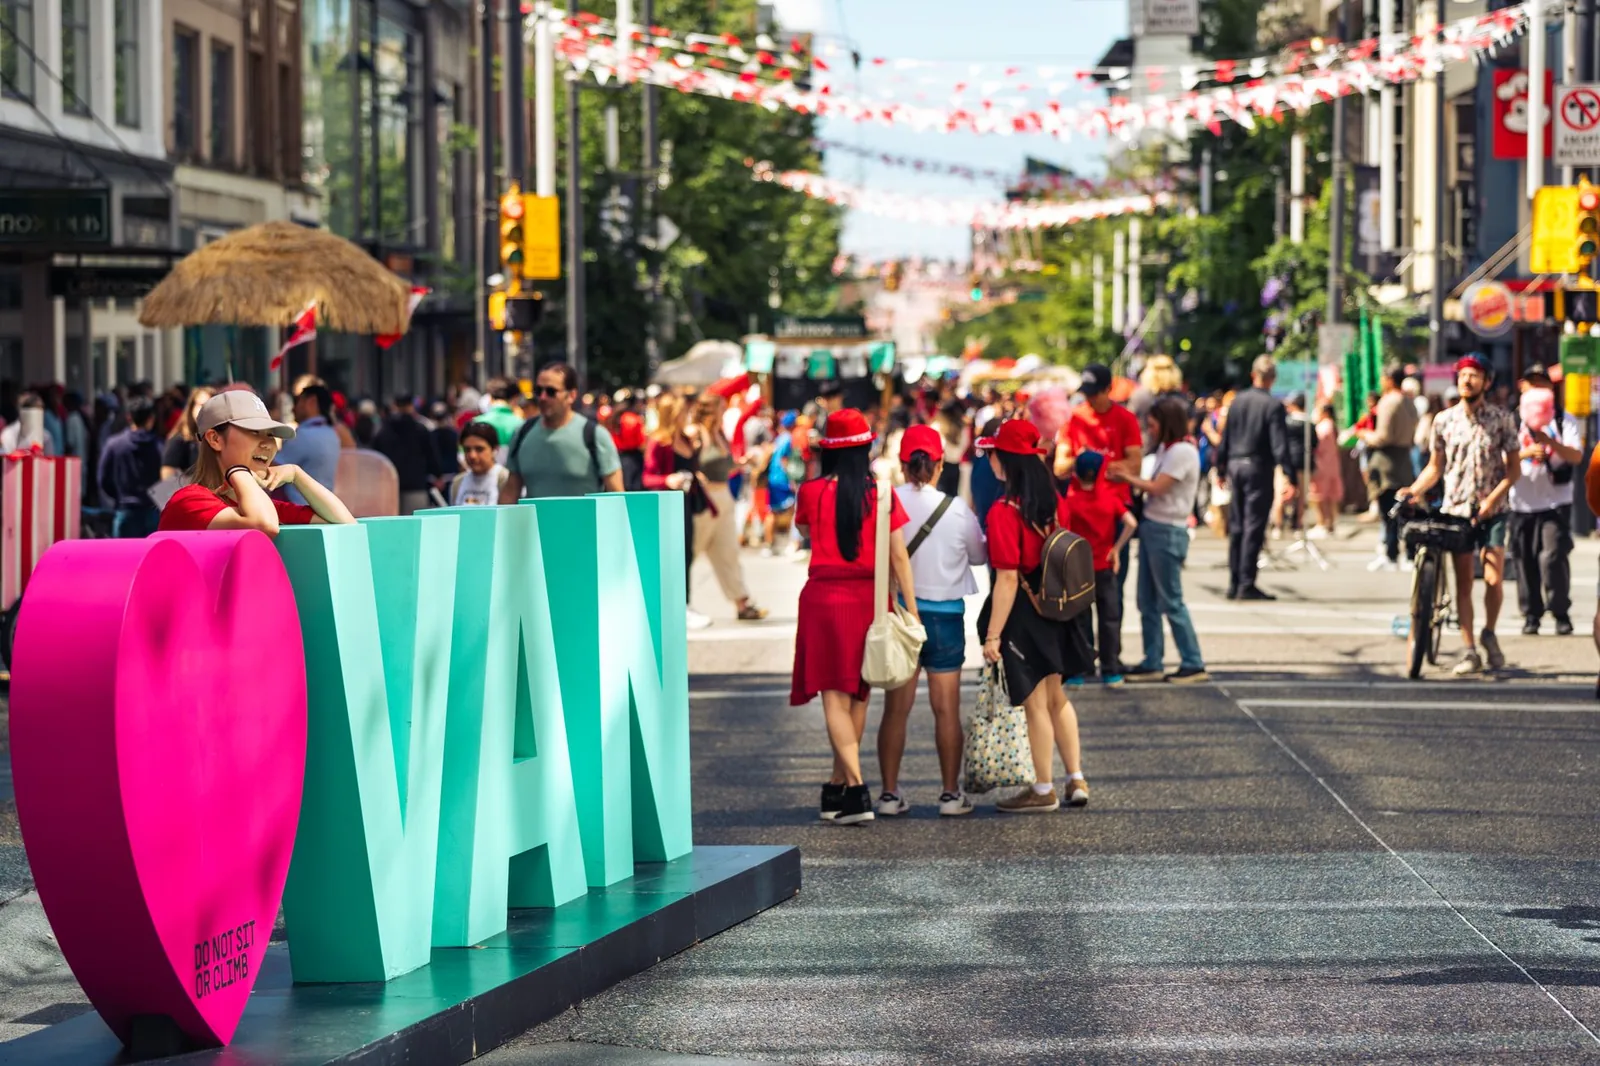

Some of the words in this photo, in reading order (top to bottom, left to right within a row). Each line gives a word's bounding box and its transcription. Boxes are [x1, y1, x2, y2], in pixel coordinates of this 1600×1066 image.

[320, 491, 692, 982] VAN
[194, 941, 210, 970] DO
[212, 929, 234, 962] NOT
[236, 920, 255, 951] SIT
[195, 970, 211, 999] OR
[213, 953, 248, 991] CLIMB
